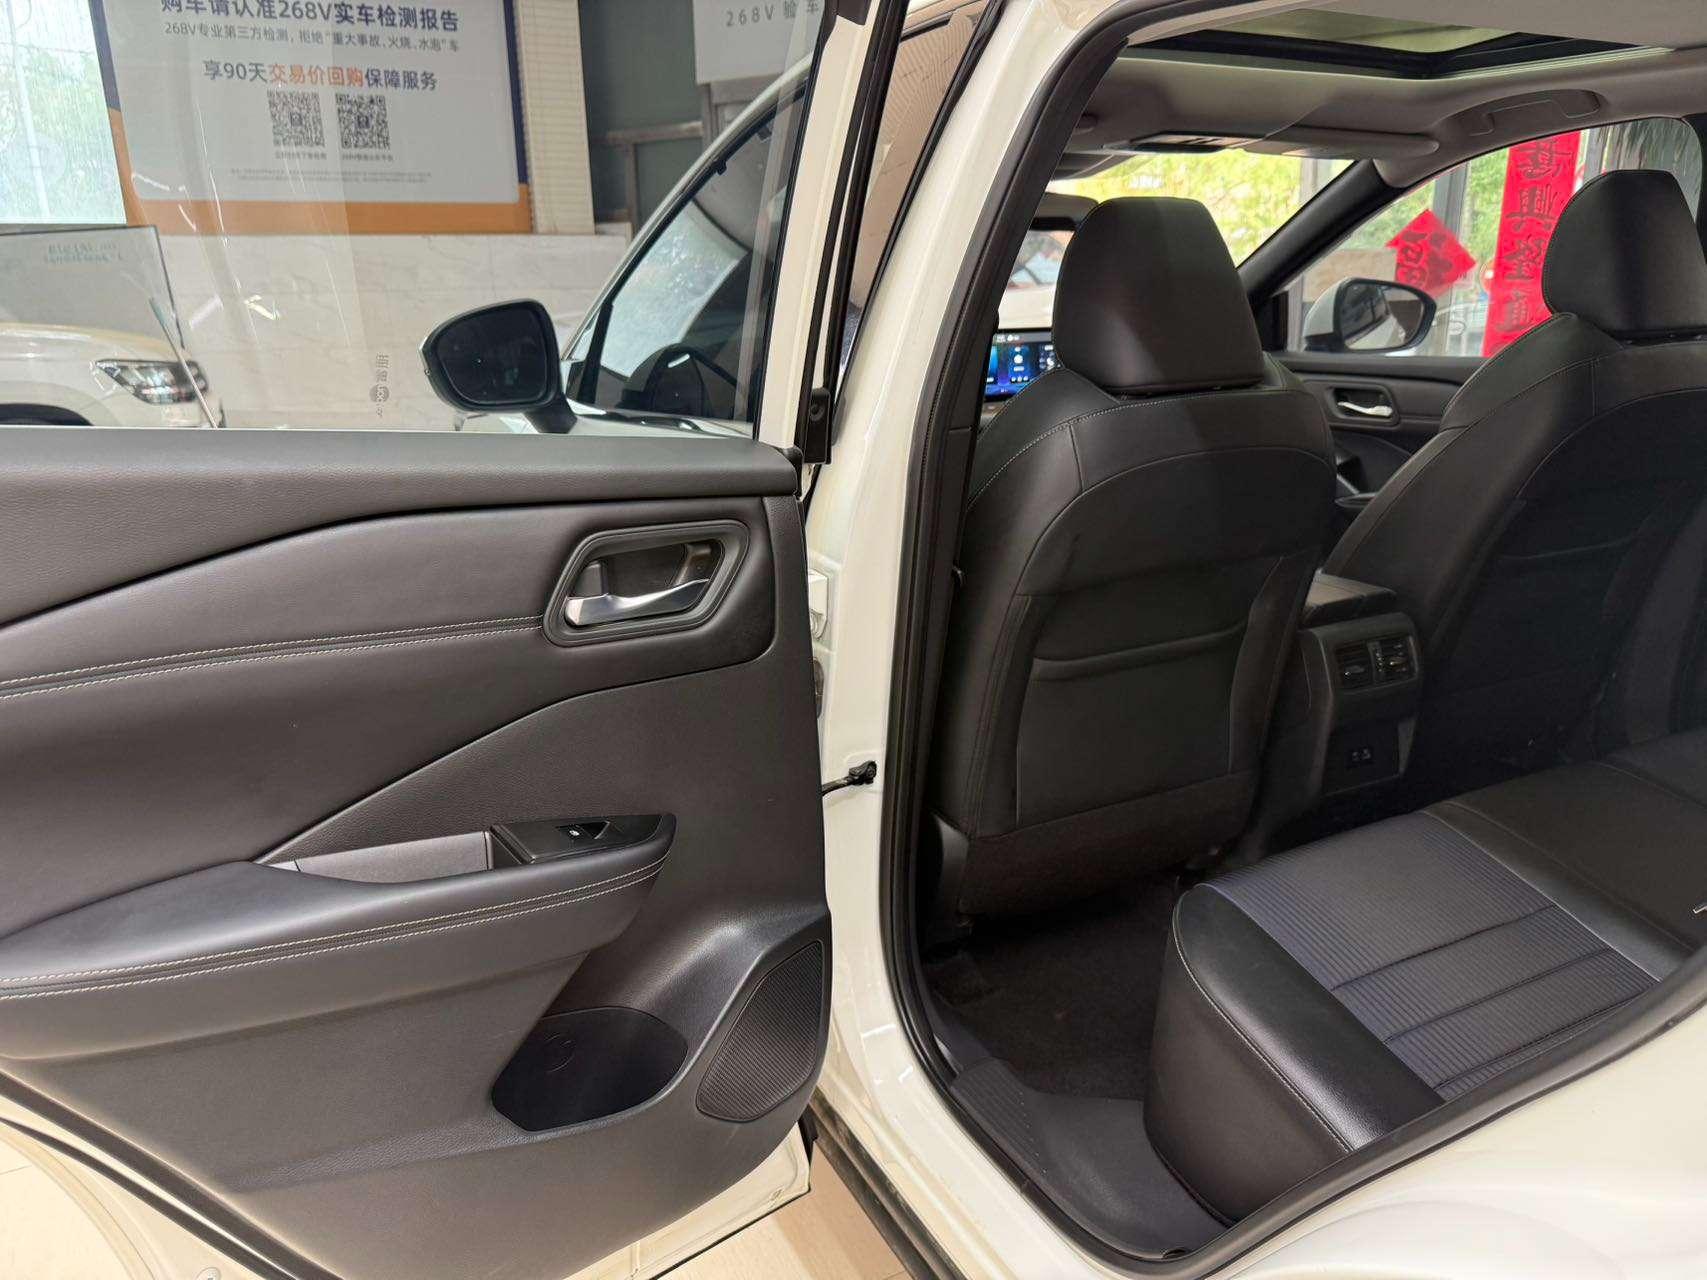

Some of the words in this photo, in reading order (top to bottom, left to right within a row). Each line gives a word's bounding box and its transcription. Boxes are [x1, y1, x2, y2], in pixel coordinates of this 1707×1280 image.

[203, 59, 438, 91] 享90天交易价回购保障服务
